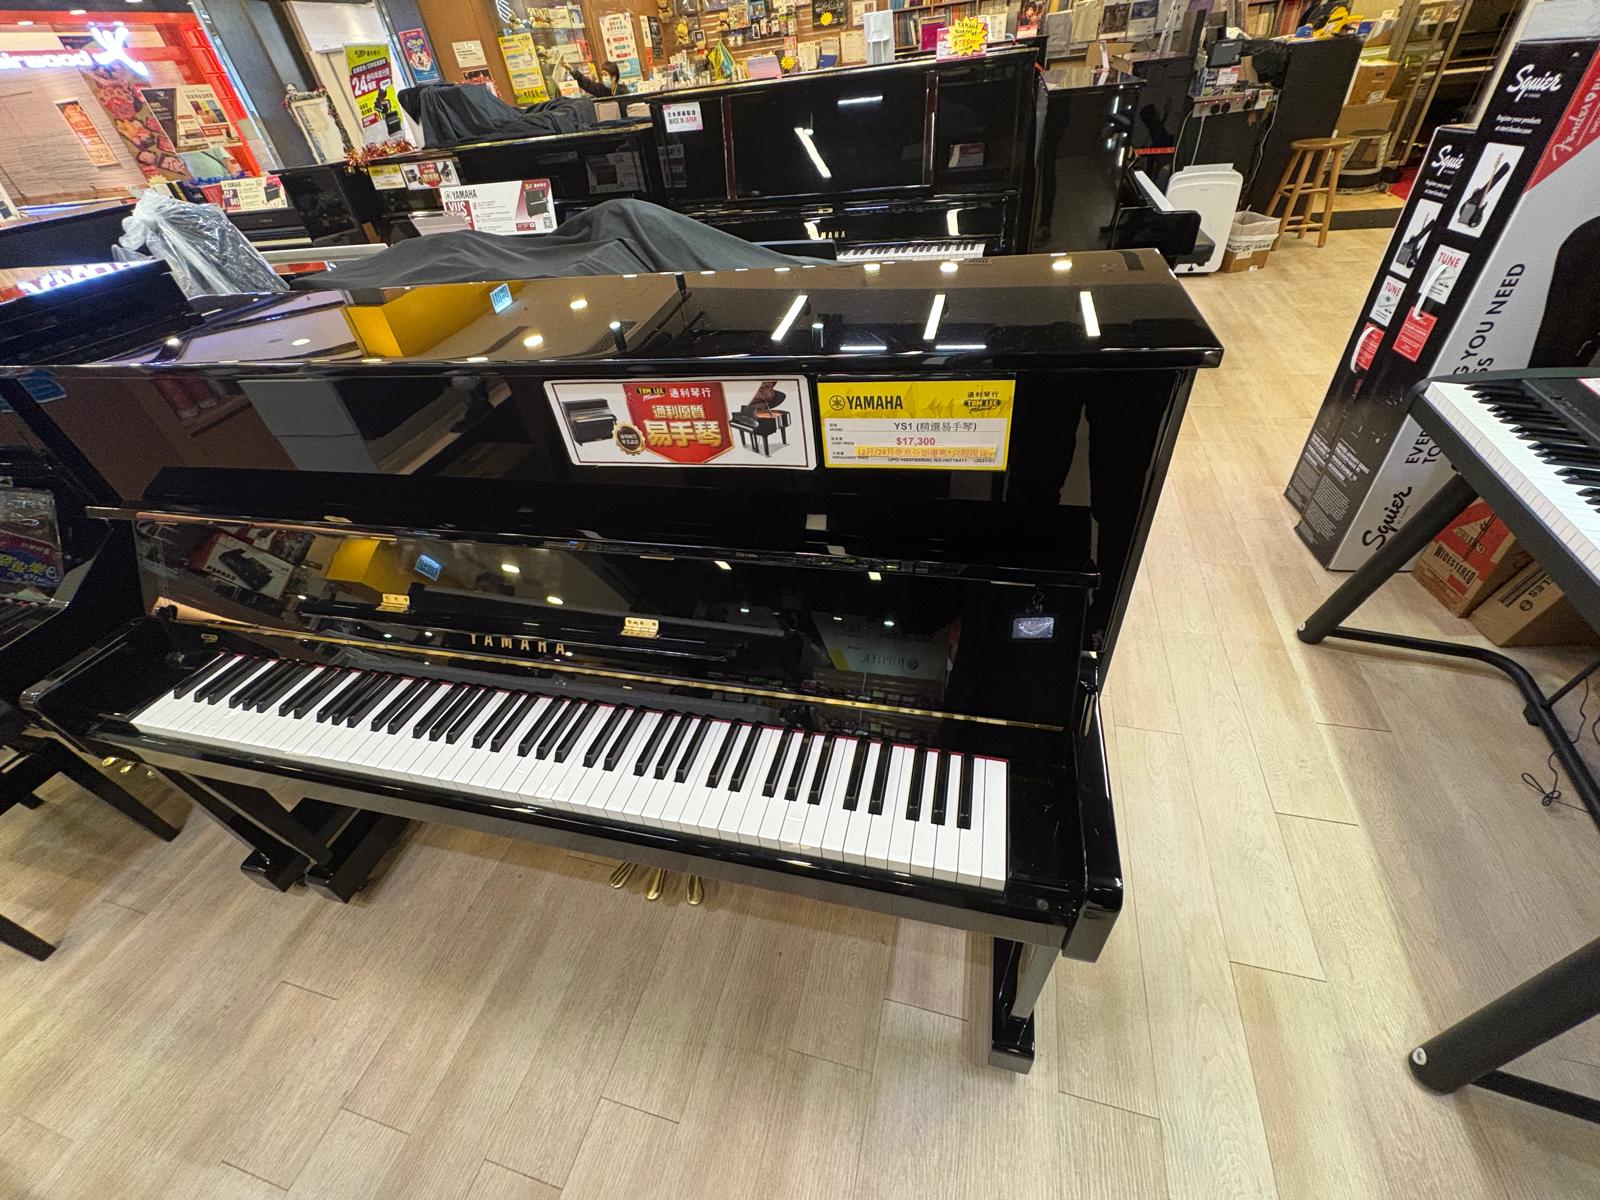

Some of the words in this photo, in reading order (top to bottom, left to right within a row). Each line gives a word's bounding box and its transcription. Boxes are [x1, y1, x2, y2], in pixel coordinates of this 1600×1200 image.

[352, 76, 368, 97] 24
[1506, 64, 1562, 102] Squier
[1552, 100, 1593, 161] Fender
[452, 189, 478, 200] YAMAHA
[1440, 252, 1461, 269] TUNE
[1385, 282, 1402, 297] TUNE
[1461, 321, 1495, 361] YOU
[1485, 264, 1526, 315] NEED
[670, 387, 711, 398] 通利琴行
[652, 405, 706, 419] 通利優質
[846, 395, 904, 410] YAMAHA
[644, 420, 722, 447] 易手琴
[894, 422, 913, 430] YS1
[896, 437, 936, 446] $17,300
[1362, 486, 1413, 551] Squier
[1433, 544, 1477, 585] WIDESTEREO
[469, 633, 566, 656] YAMAHA
